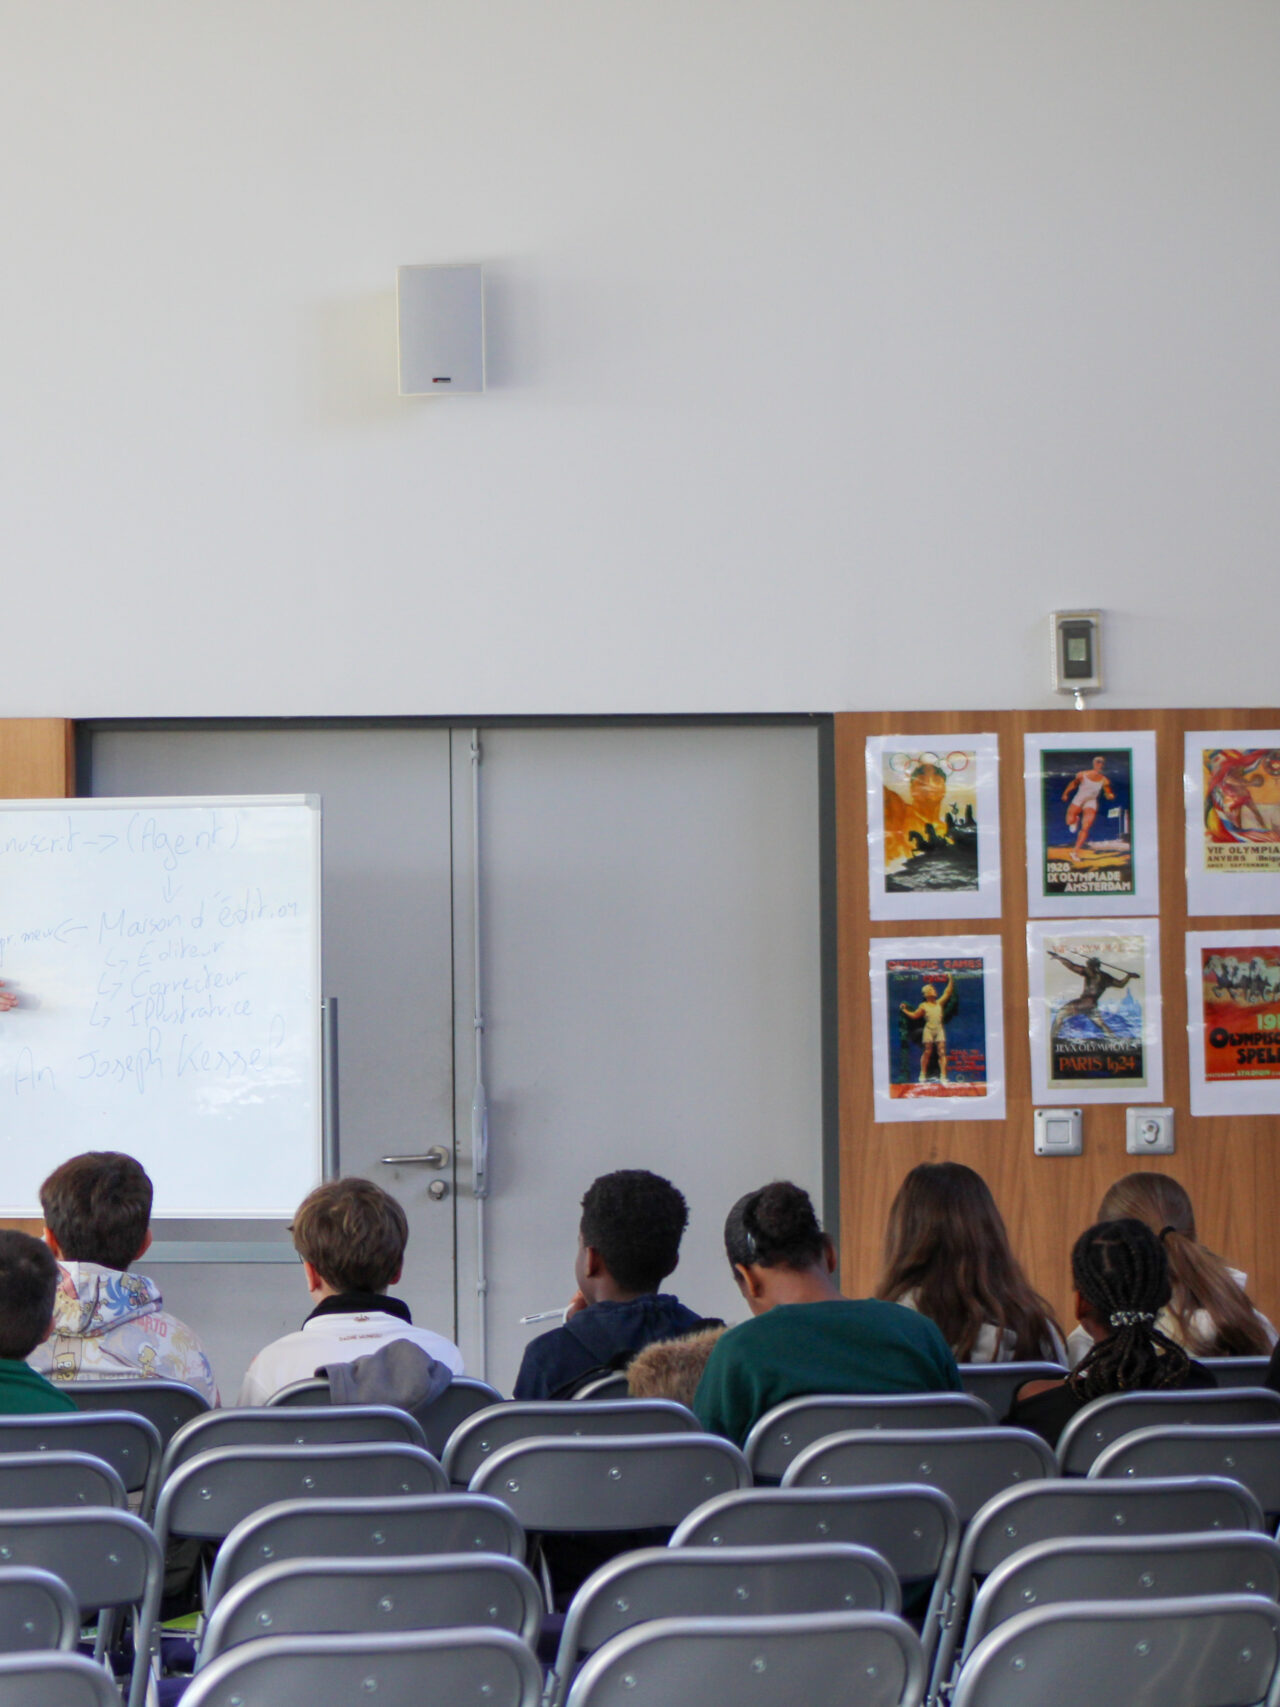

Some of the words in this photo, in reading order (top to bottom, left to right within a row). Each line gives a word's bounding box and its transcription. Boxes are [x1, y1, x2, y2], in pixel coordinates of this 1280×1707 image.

[126, 810, 240, 871] (Agent)
[1047, 862, 1071, 873] 1928
[1047, 872, 1058, 883] IX
[1060, 870, 1121, 882] OLYMPIADE
[1063, 881, 1131, 893] AMSTERDAM
[98, 908, 182, 945] Maison
[887, 960, 939, 970] OLYMPIC
[943, 959, 983, 969] GAMES
[76, 1026, 164, 1095] Joseph
[177, 1013, 287, 1079] Kessel
[1059, 1057, 1103, 1072] PARIS
[1106, 1055, 1136, 1074] 1924
